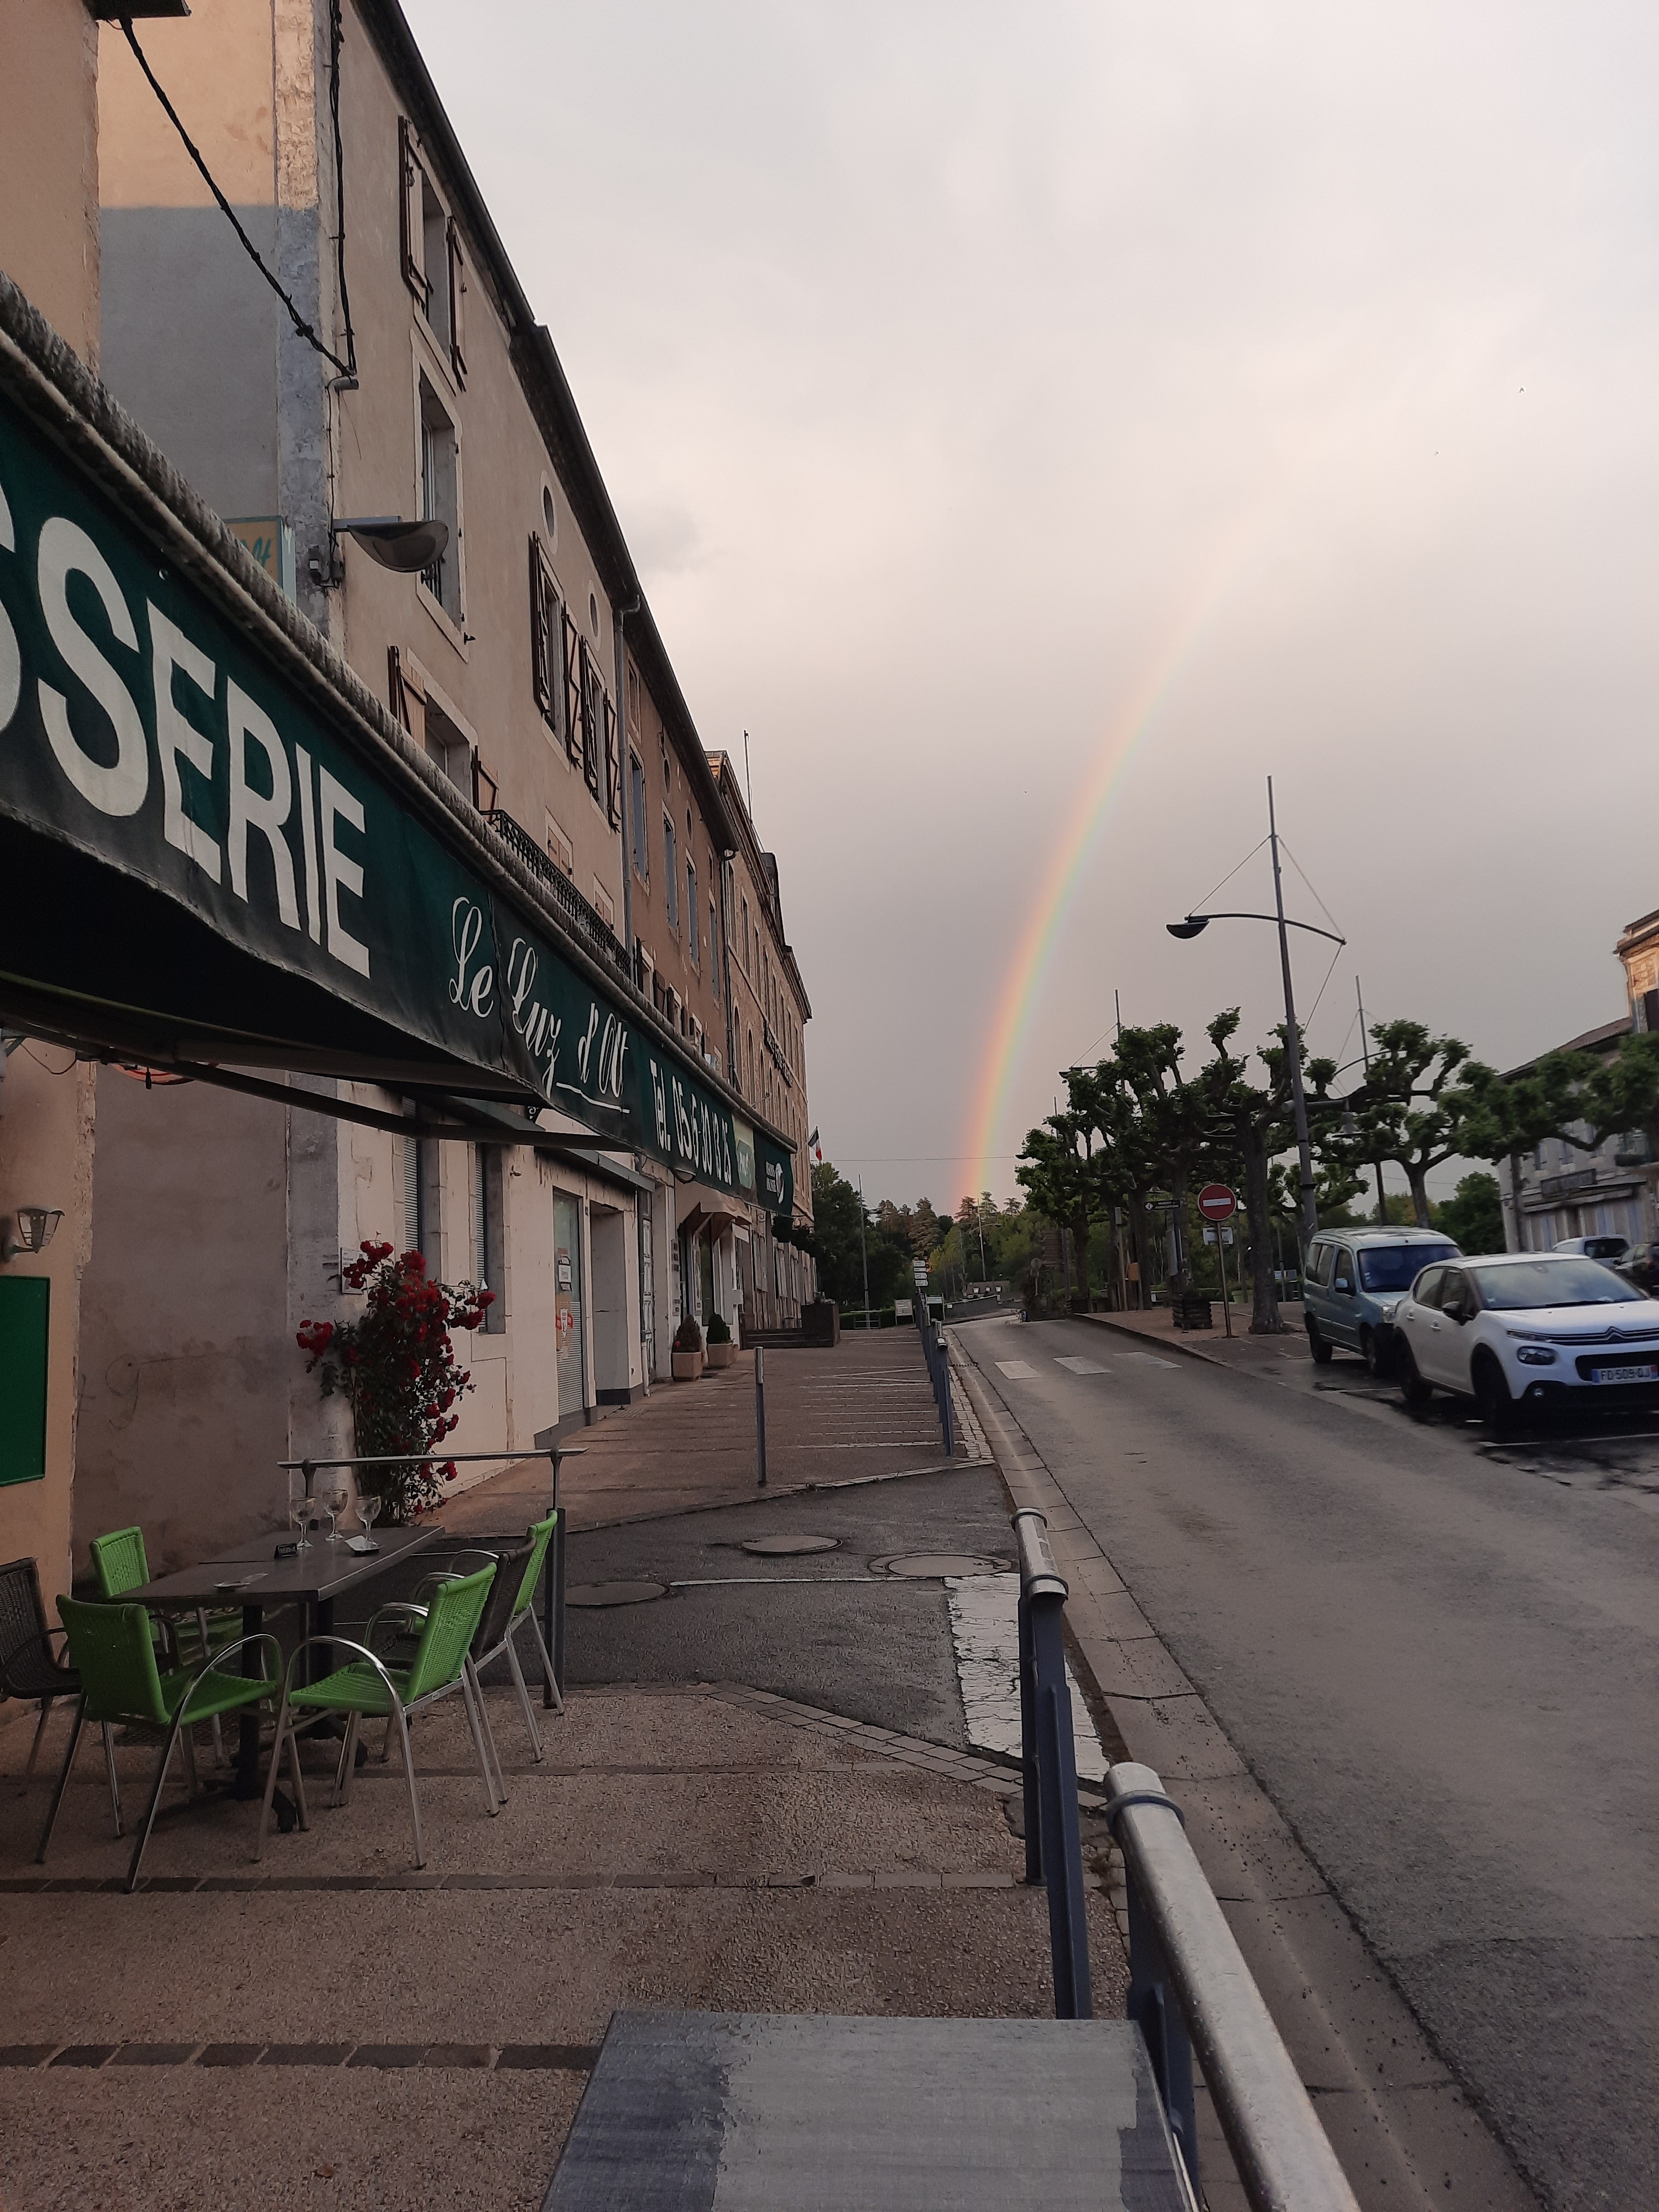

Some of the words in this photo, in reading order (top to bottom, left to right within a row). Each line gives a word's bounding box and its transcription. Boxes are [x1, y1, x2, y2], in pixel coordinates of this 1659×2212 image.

[0, 483, 370, 979] SERIE
[449, 896, 494, 1018] Le
[507, 938, 561, 1099] Luz
